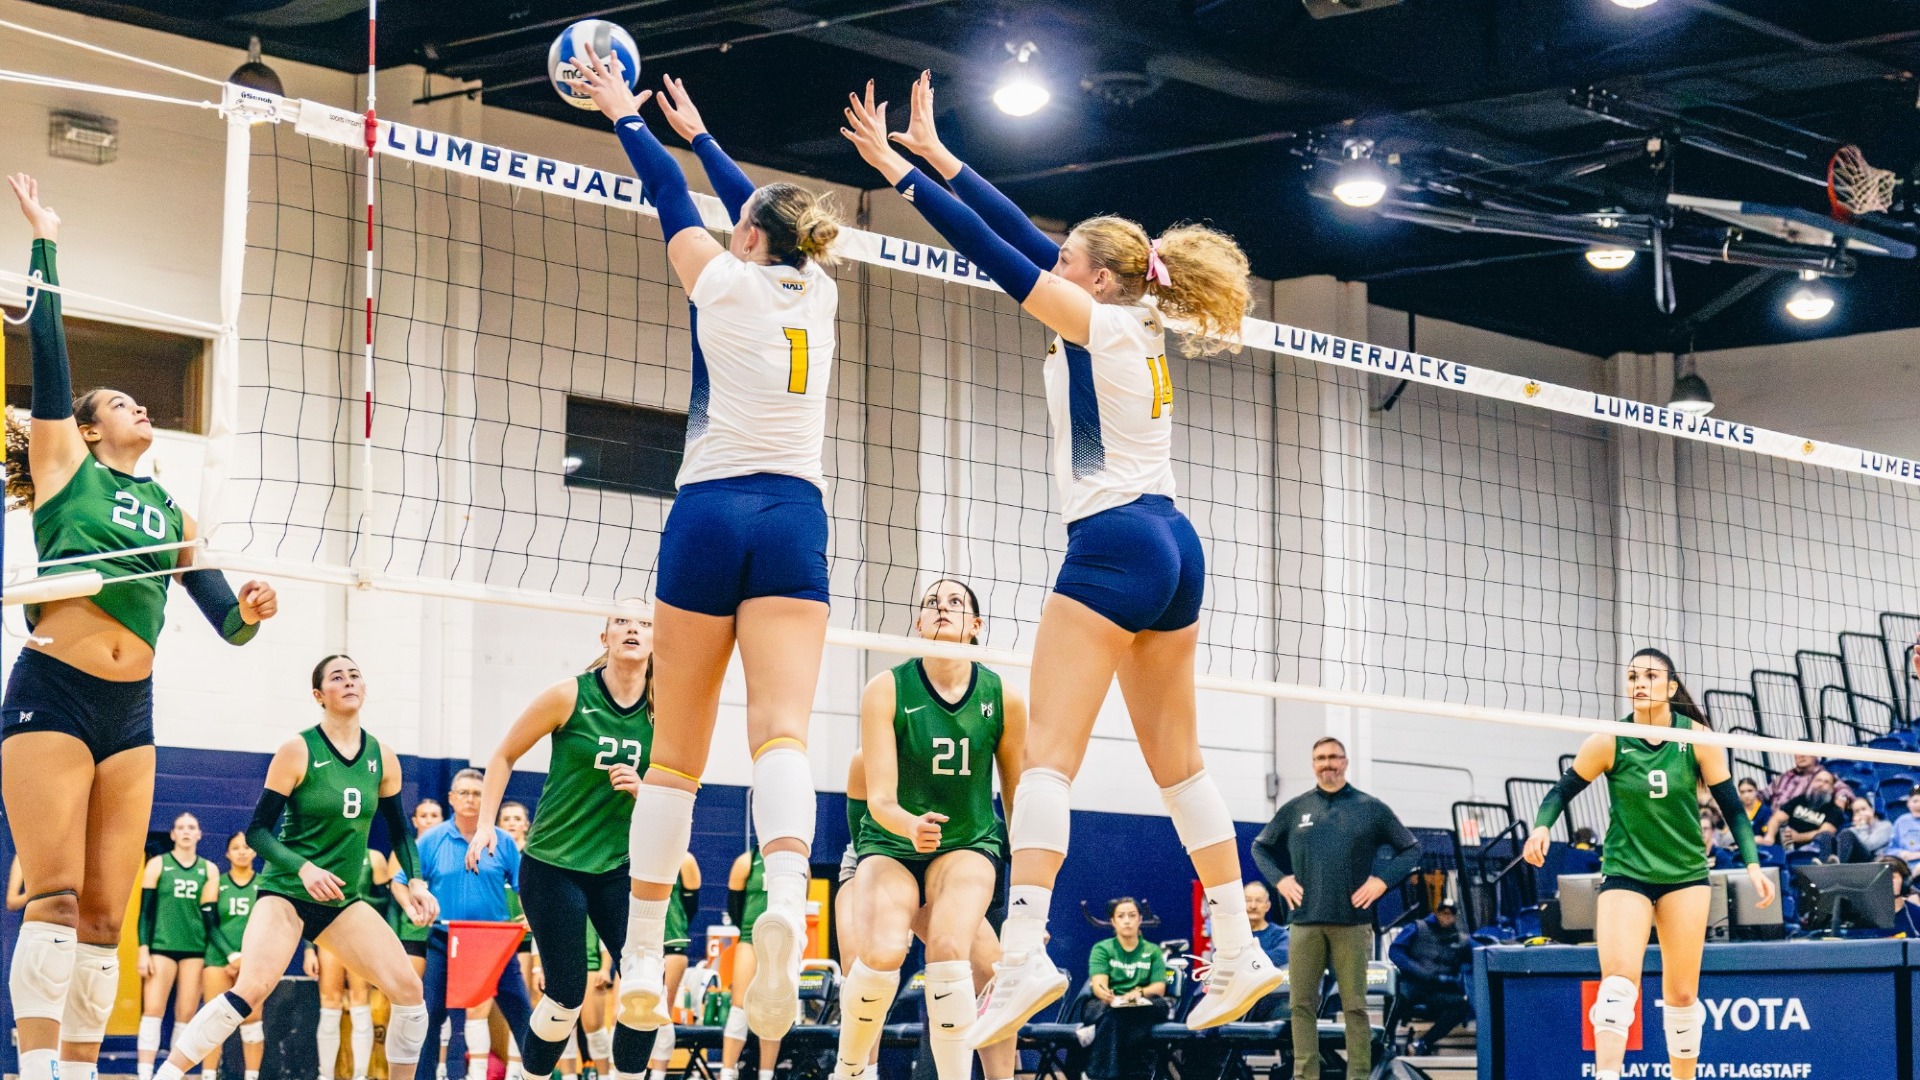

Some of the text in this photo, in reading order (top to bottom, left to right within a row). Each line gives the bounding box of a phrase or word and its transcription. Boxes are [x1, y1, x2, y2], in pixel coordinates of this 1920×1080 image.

[782, 326, 809, 395] 1
[1274, 325, 1467, 385] LUMBERJACKS
[1593, 395, 1755, 445] LUMBERJACKS
[111, 490, 166, 540] 20
[593, 735, 642, 772] 23
[932, 737, 972, 776] 21
[1647, 769, 1669, 799] 9
[342, 787, 362, 819] 8
[173, 878, 199, 900] 22
[228, 897, 250, 916] 15
[707, 939, 720, 957] G
[1654, 997, 1811, 1032] YOTA
[1581, 1063, 1812, 1079] FILAY TOTA FLAGSTAFF
